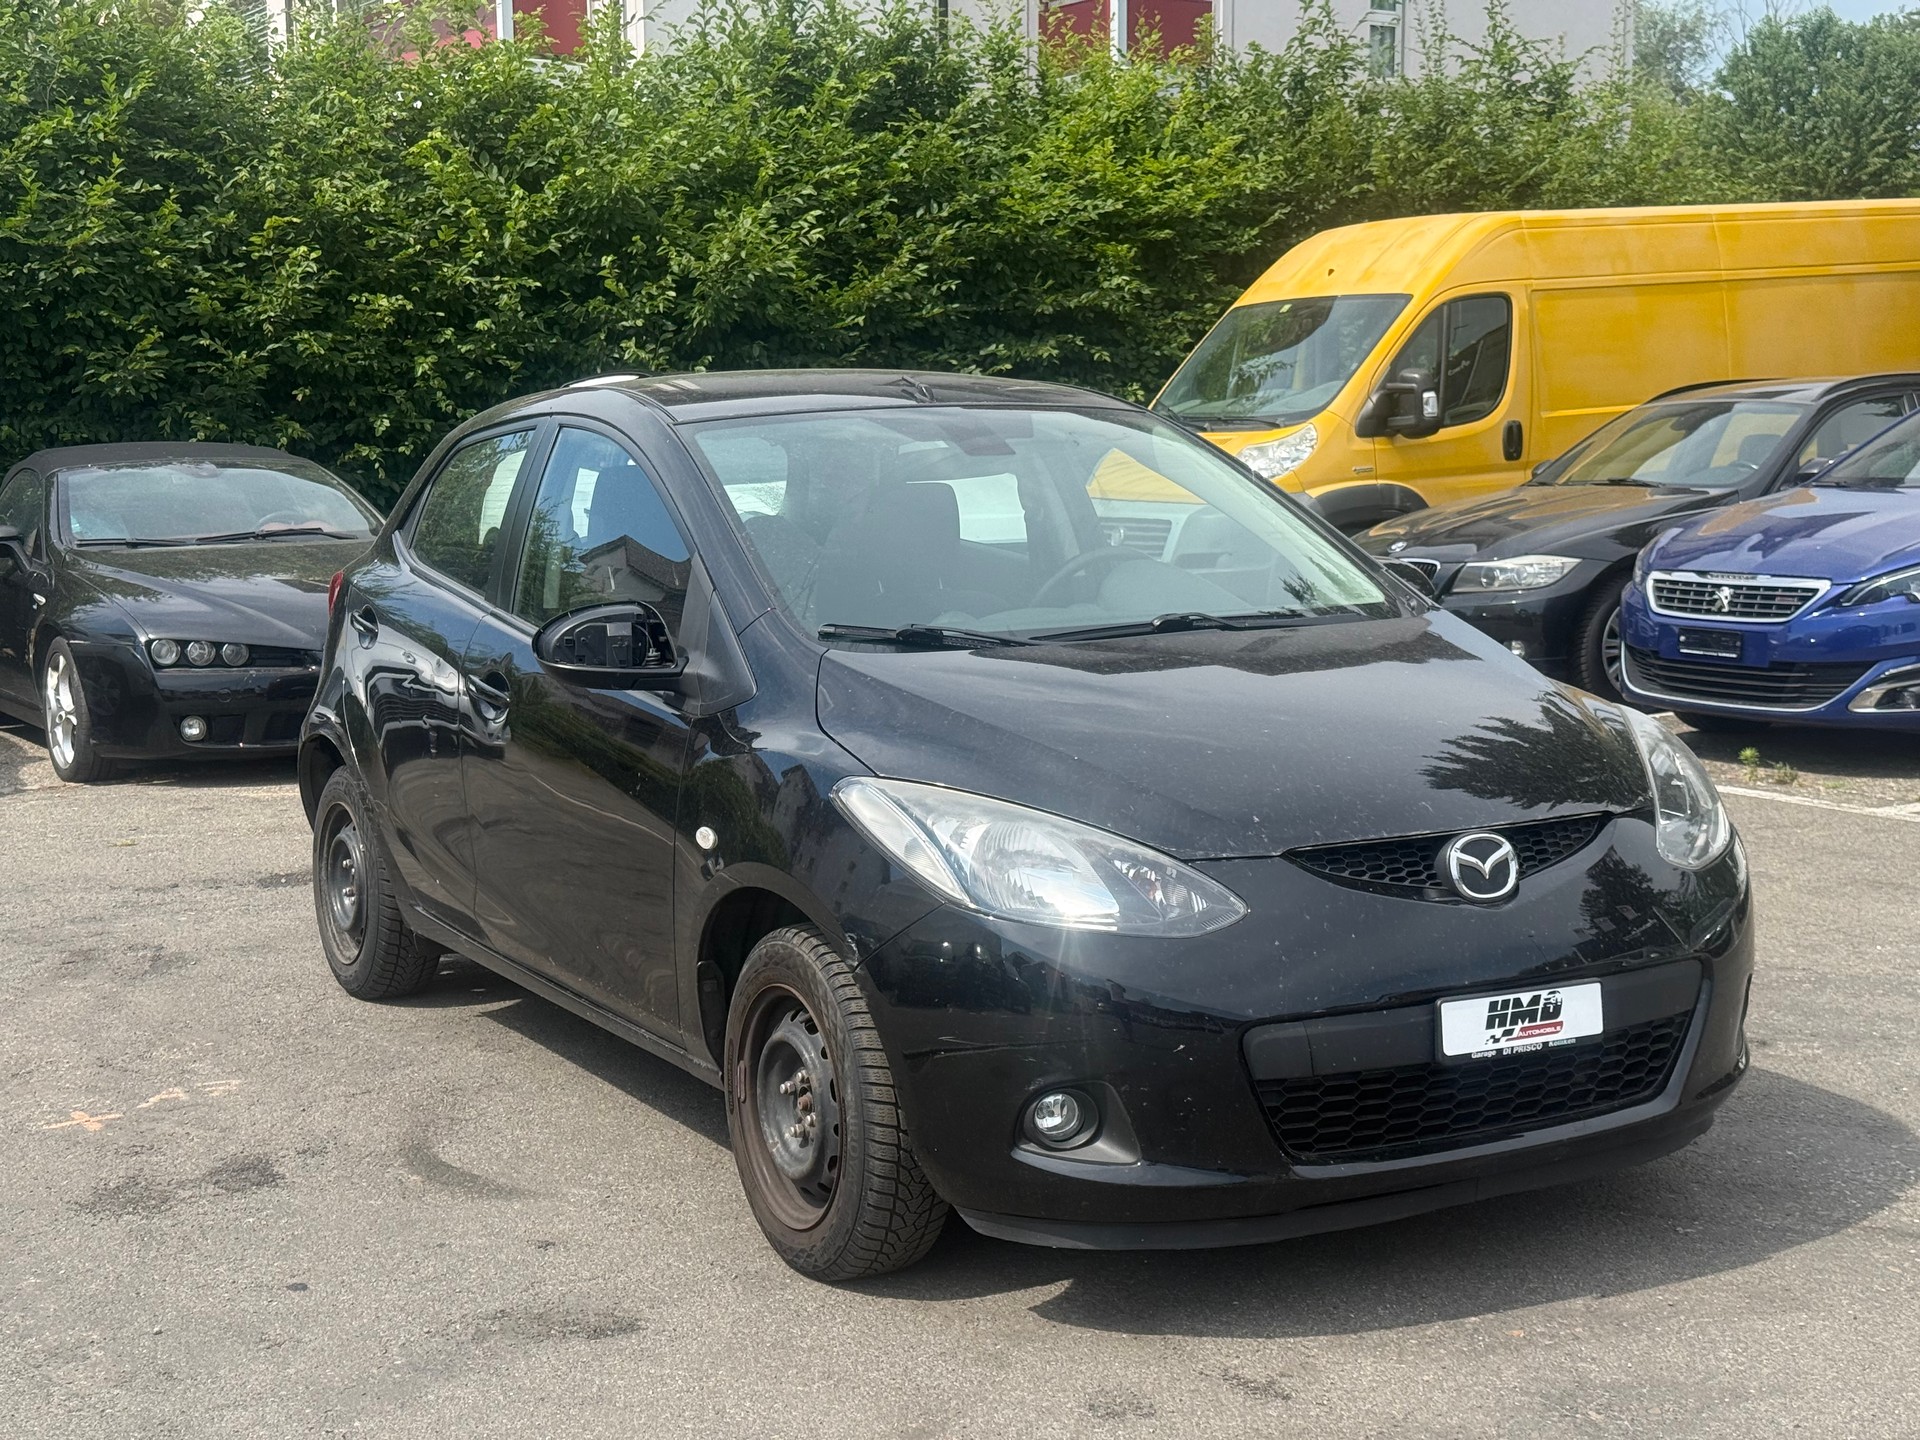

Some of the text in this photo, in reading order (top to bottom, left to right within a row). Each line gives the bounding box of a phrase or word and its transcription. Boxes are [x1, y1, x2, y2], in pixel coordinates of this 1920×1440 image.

[1485, 991, 1563, 1030] HMD
[1517, 1026, 1562, 1037] AUTOMOBILE
[1471, 1050, 1496, 1059] Garage
[1502, 1047, 1511, 1056] DI
[1513, 1042, 1543, 1054] PRISCO
